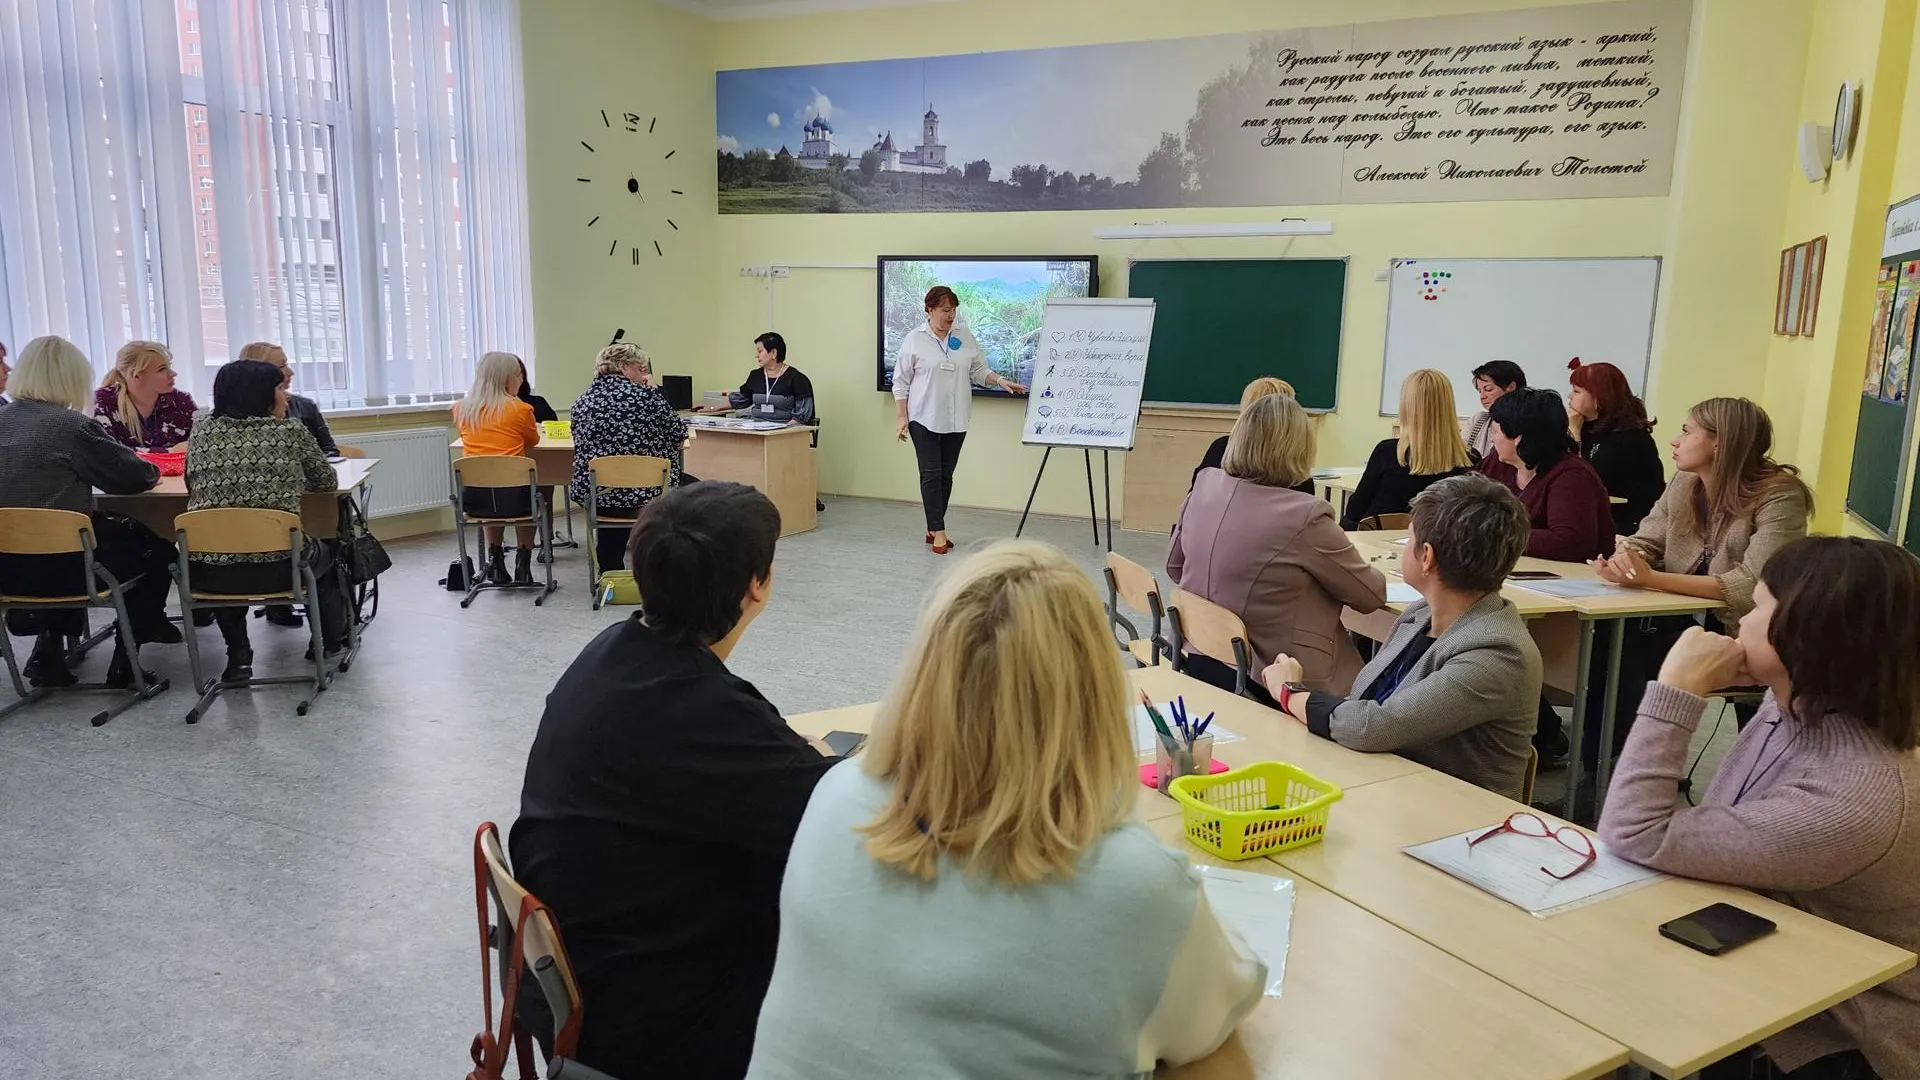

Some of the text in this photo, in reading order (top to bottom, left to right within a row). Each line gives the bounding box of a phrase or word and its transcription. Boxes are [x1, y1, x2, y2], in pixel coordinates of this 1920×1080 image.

[1277, 48, 1344, 73] Русский
[1344, 50, 1394, 68] народ
[1397, 46, 1452, 65] создал
[1449, 35, 1526, 62] русский
[1528, 36, 1575, 56] язык
[1596, 26, 1658, 52] яркий,
[1279, 49, 1656, 92] как радуга после весеннего ливня, меткий,
[1241, 87, 1660, 130] как песня над колыбелью. Что такое Родина?
[1265, 70, 1653, 111] как стрелы, певучий и богатый, задушевный,
[1261, 118, 1647, 149] Это весь народ. Это его культура, его язык.
[1353, 155, 1650, 183] Алексей Николаевич Толстой
